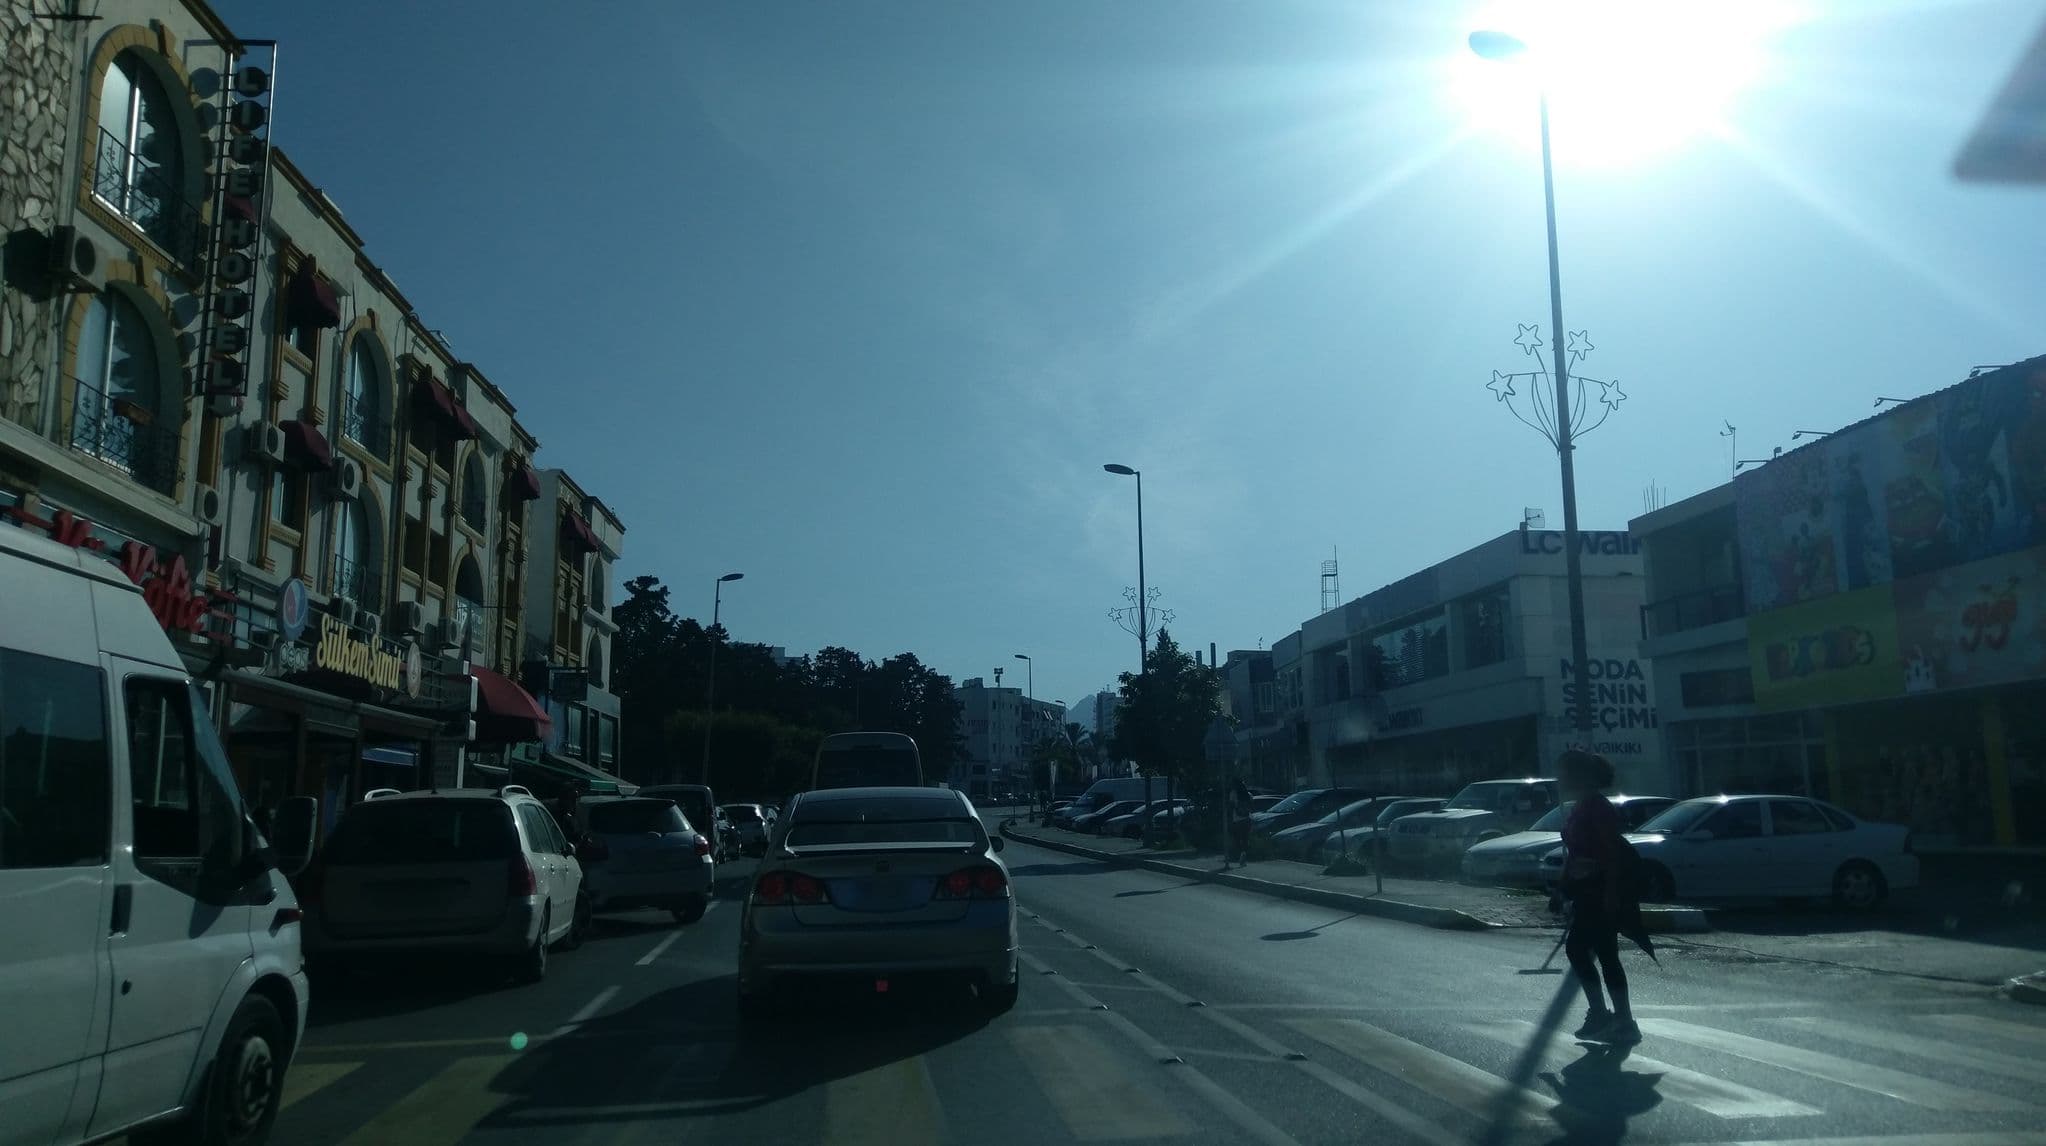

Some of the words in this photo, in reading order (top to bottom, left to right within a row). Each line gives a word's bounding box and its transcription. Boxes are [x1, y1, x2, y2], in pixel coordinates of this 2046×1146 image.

[230, 66, 268, 198] LIFE
[208, 217, 254, 391] HOTEL
[1559, 658, 1644, 680] MODA
